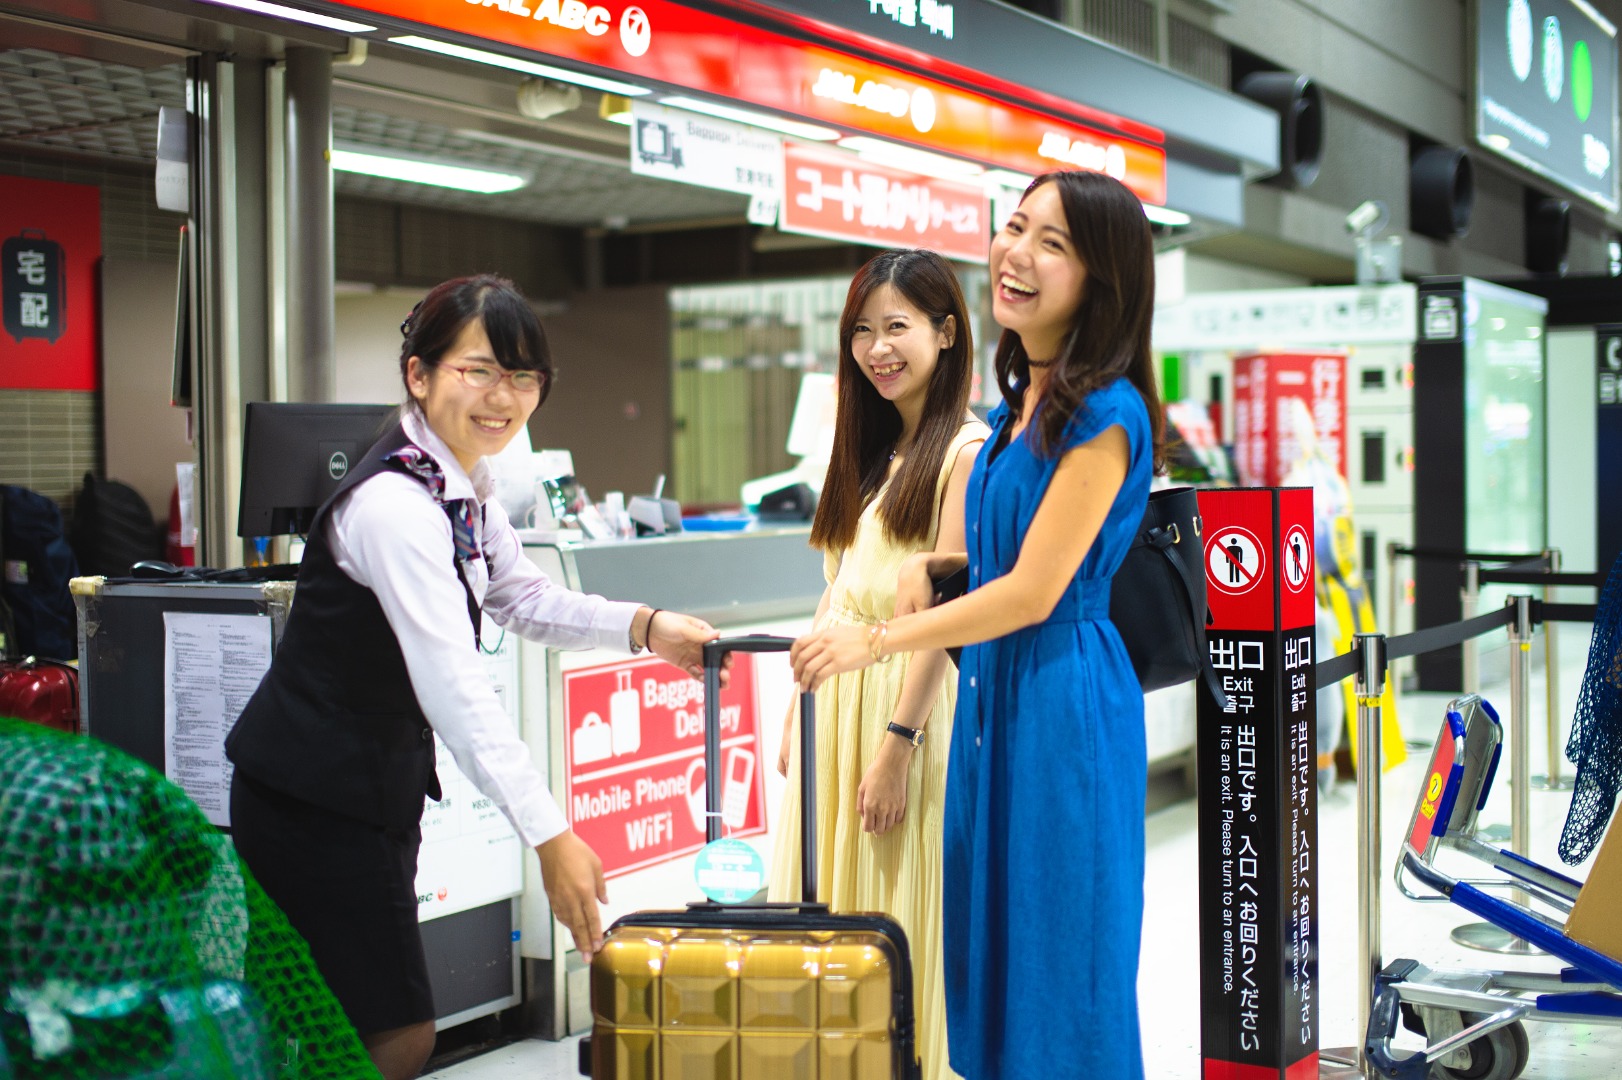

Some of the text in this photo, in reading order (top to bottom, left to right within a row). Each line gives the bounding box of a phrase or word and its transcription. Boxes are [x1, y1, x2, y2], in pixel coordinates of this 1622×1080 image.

[533, 0, 611, 36] ABC
[17, 249, 49, 328] 宅配
[331, 461, 346, 470] DELL
[1209, 638, 1264, 671] 出口
[1285, 636, 1311, 671] 出口
[643, 678, 705, 710] Baggag
[1223, 676, 1254, 692] Exit
[1291, 673, 1306, 690] Exit
[1223, 695, 1255, 714] 출구
[1291, 691, 1307, 713] 출구
[674, 704, 741, 739] Delery
[1291, 754, 1297, 771] an
[573, 774, 688, 822] Mobile Phone
[625, 811, 673, 852] WiFi
[1221, 725, 1235, 994] It is an exit. Please turn to an entrance.
[1292, 891, 1299, 906] to
[1292, 909, 1298, 927] an
